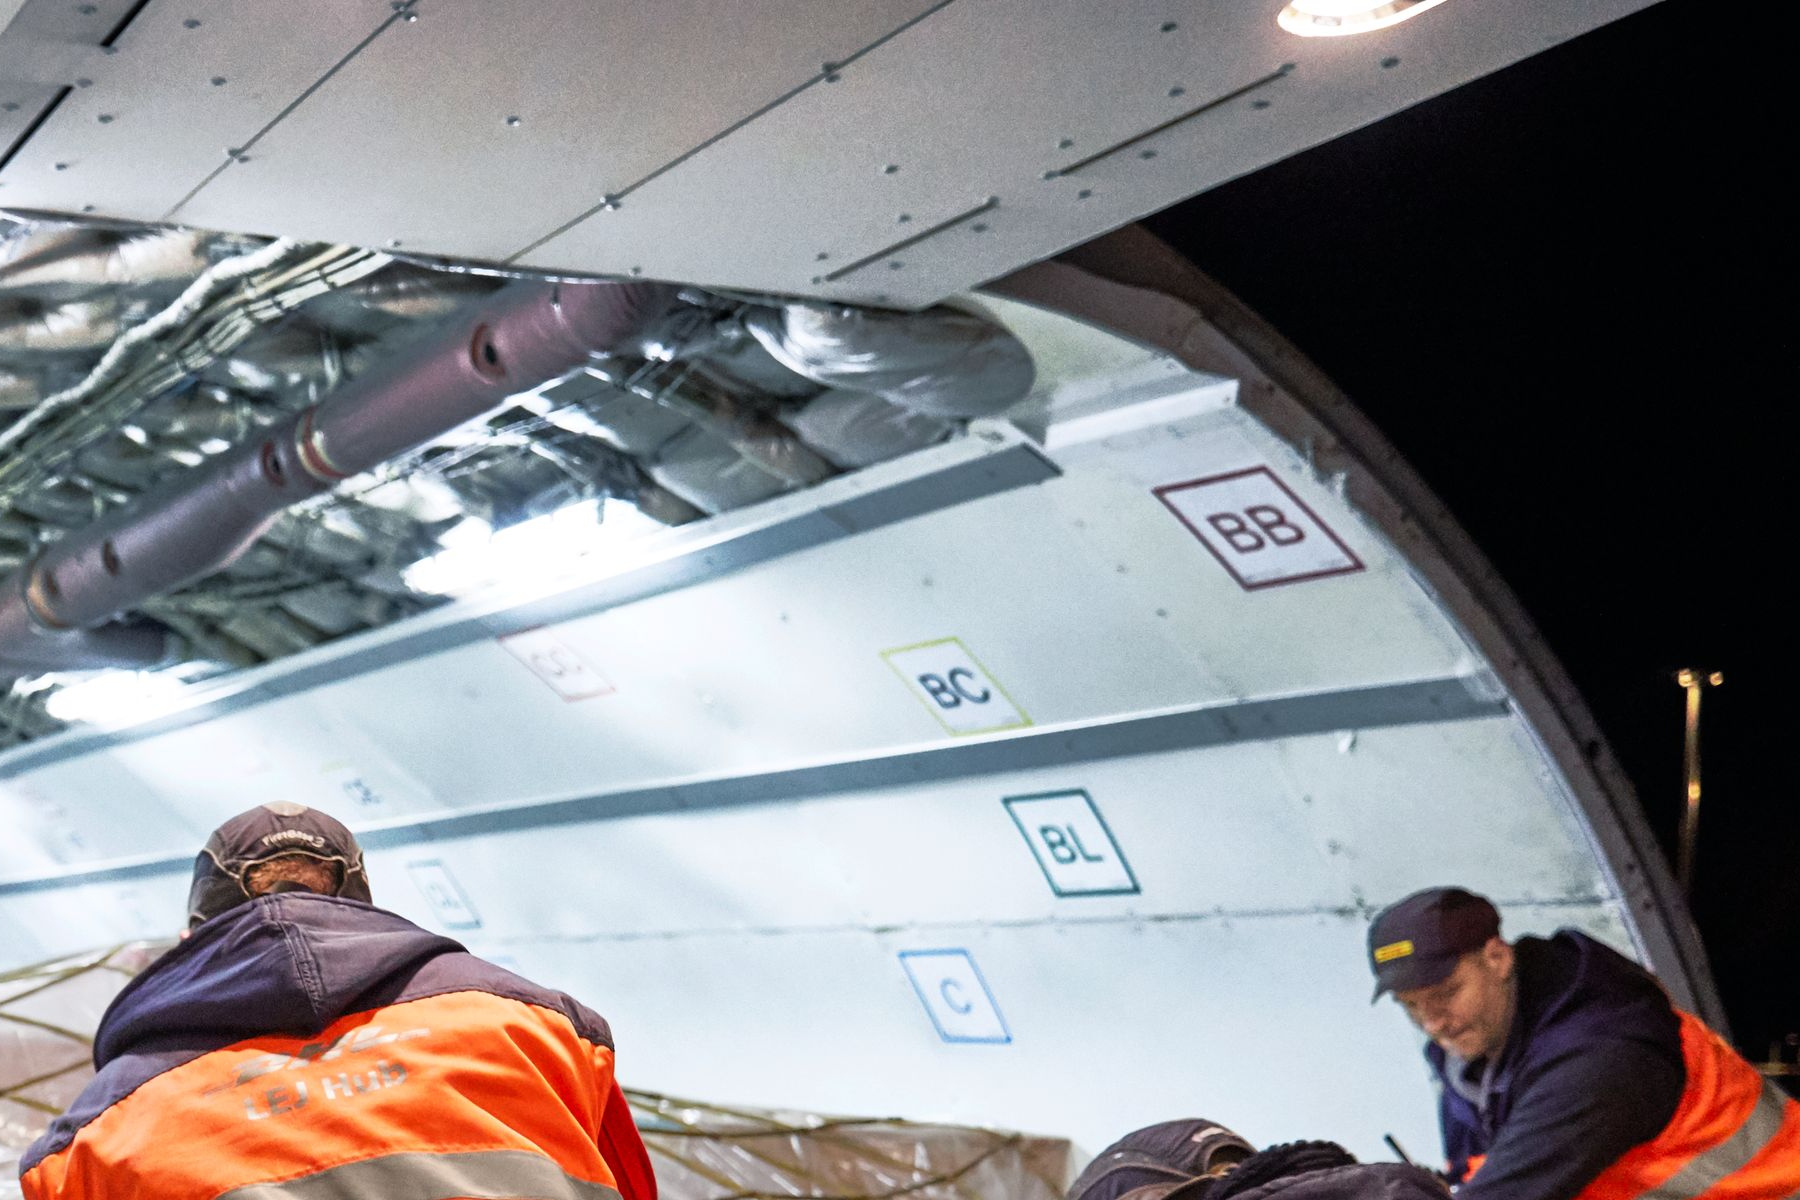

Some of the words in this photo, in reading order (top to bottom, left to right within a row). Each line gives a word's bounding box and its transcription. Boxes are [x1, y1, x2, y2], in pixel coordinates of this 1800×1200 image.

[1206, 504, 1306, 554] BB
[917, 666, 991, 709] BC
[1038, 822, 1104, 865] BL
[940, 977, 972, 1016] C
[243, 1080, 308, 1121] LEJ
[321, 1059, 408, 1100] Hub
